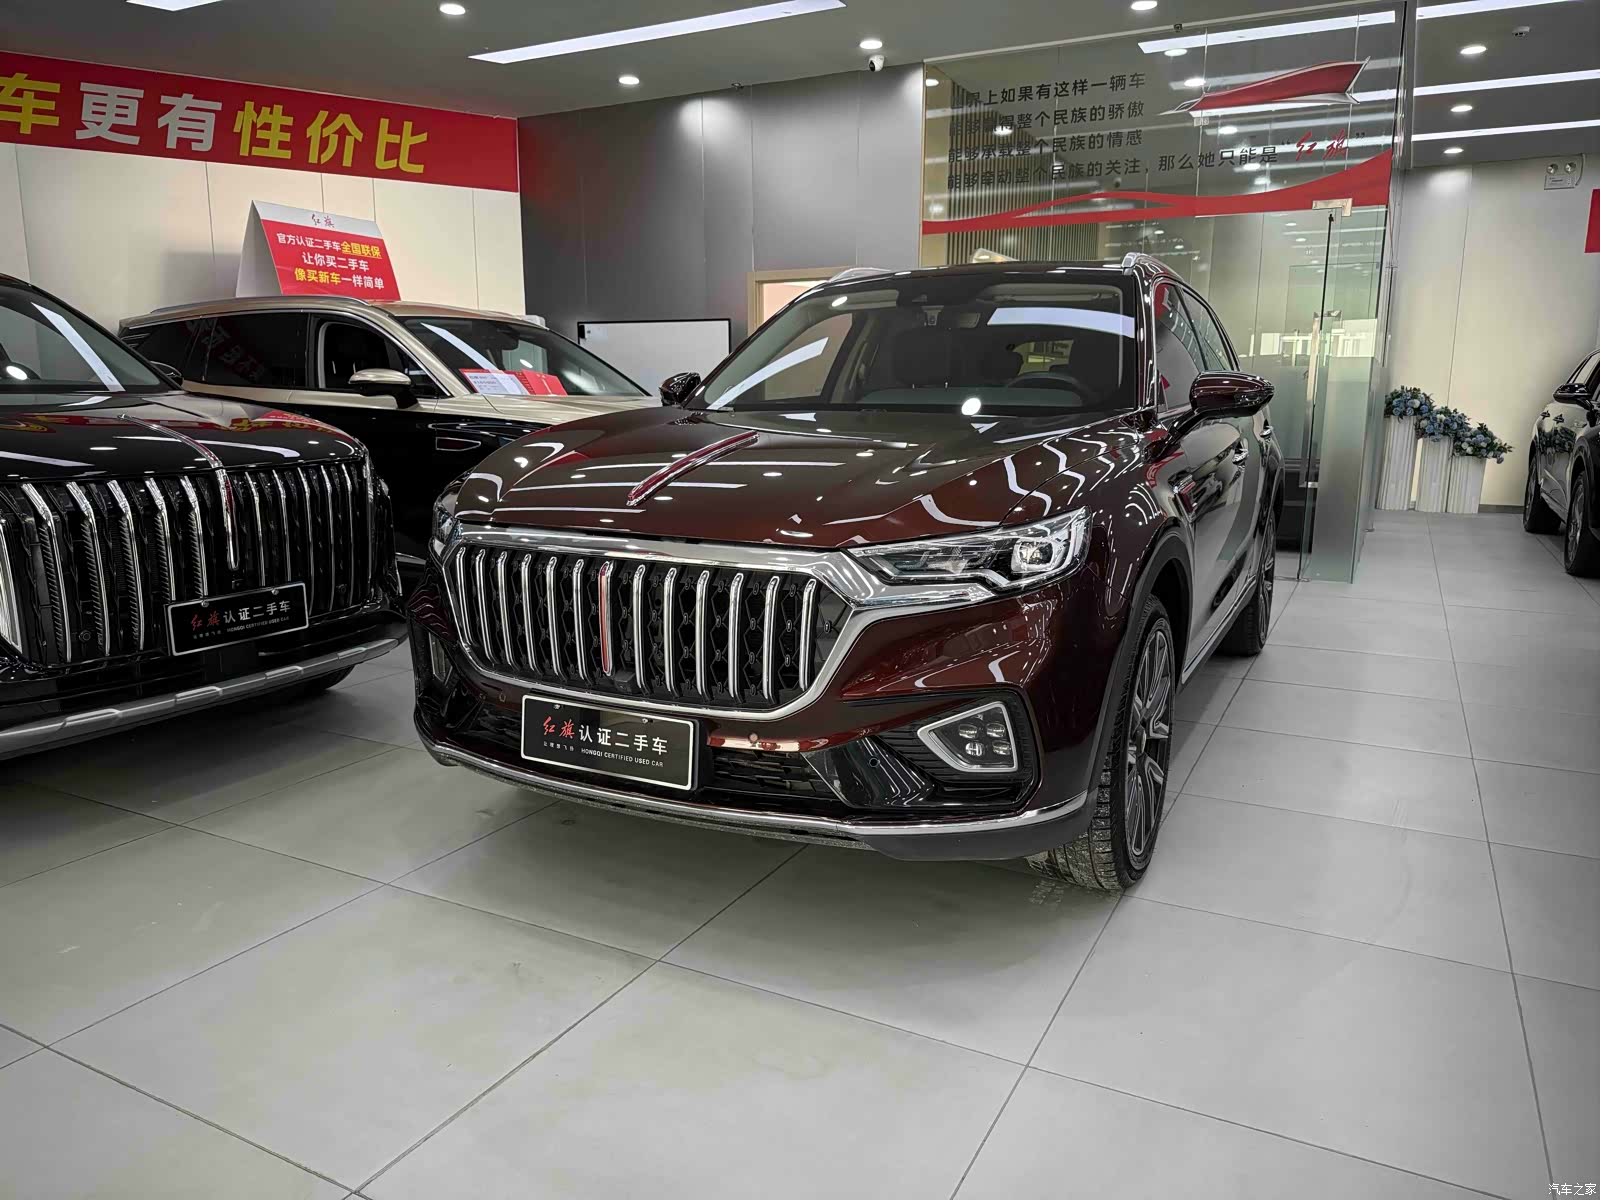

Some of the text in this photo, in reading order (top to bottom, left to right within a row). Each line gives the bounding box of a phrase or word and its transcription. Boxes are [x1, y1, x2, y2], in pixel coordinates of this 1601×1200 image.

[0, 73, 428, 174] 车更有性价比
[948, 129, 1142, 163] 能够承载整个民族的情感
[311, 213, 335, 228] 红旗
[301, 252, 370, 272] 让你买二手车
[294, 267, 385, 290] 像买新车一样简单
[581, 748, 664, 768] HONGQI CERTIFIED USED CAR
